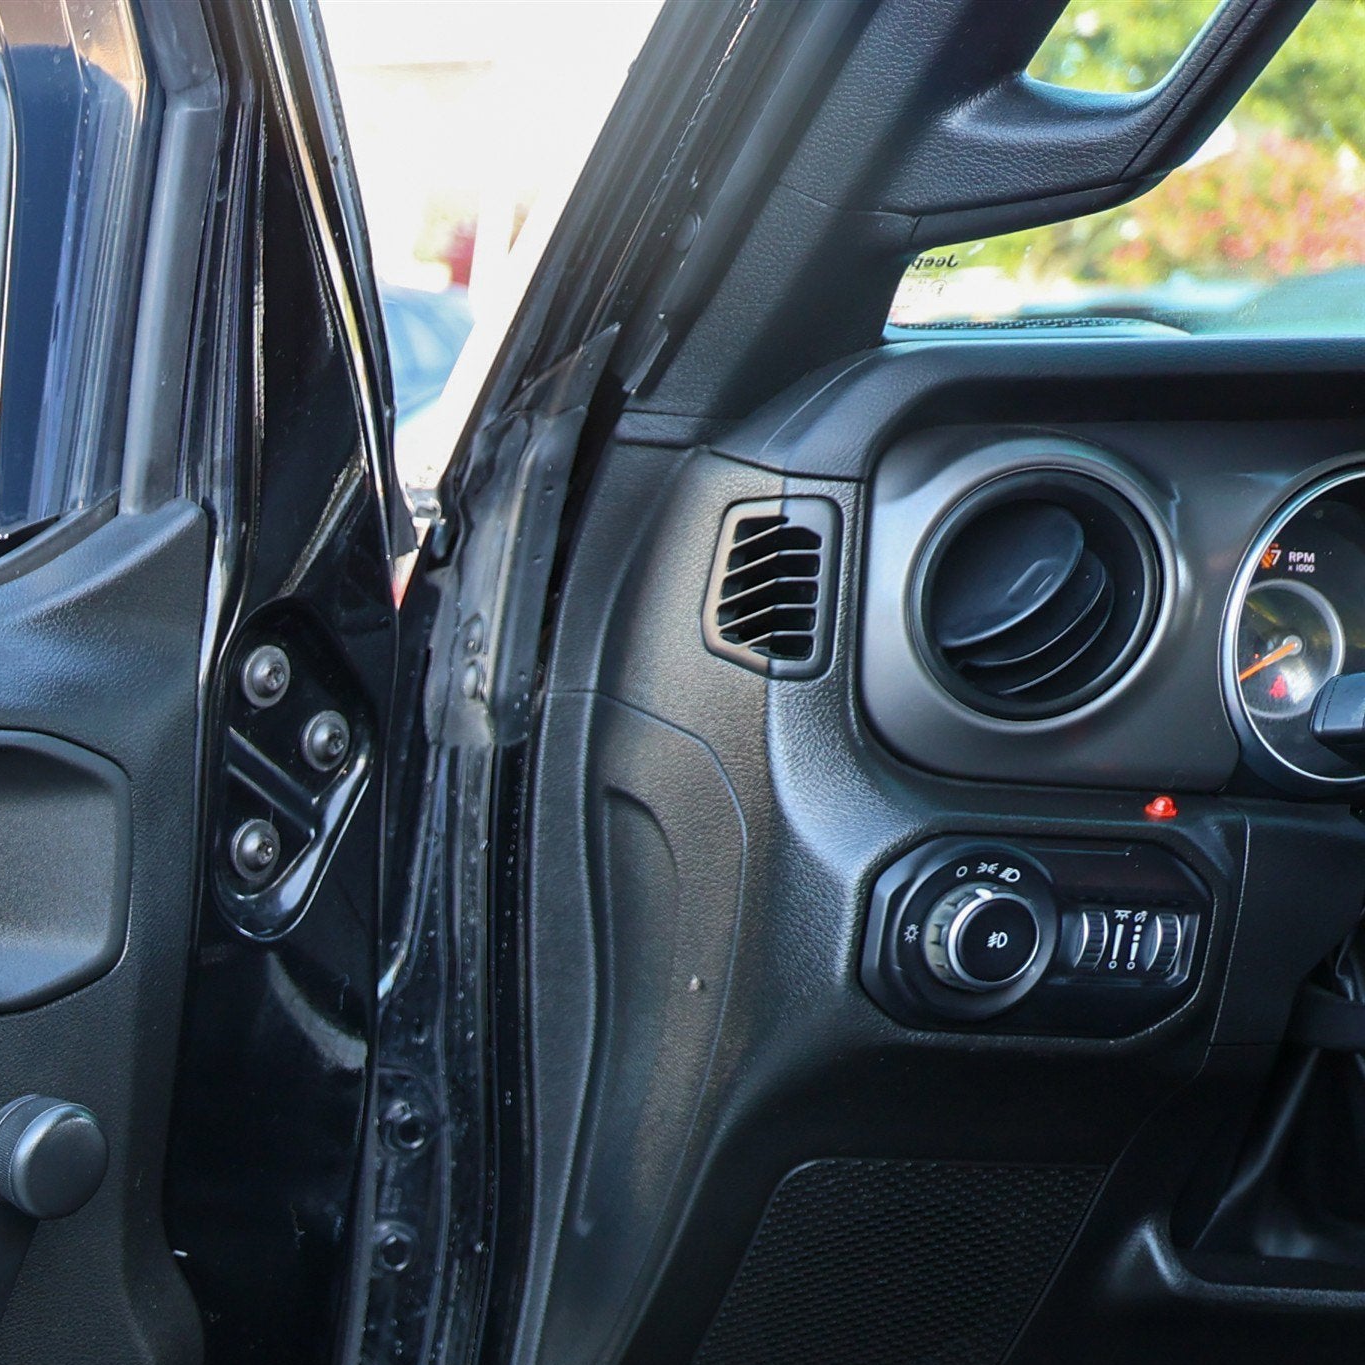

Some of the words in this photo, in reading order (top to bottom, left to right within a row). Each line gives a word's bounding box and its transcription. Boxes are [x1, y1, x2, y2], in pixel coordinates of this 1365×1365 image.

[1270, 549, 1282, 566] 7
[1288, 551, 1315, 563] RPM
[1295, 564, 1315, 573] 1000
